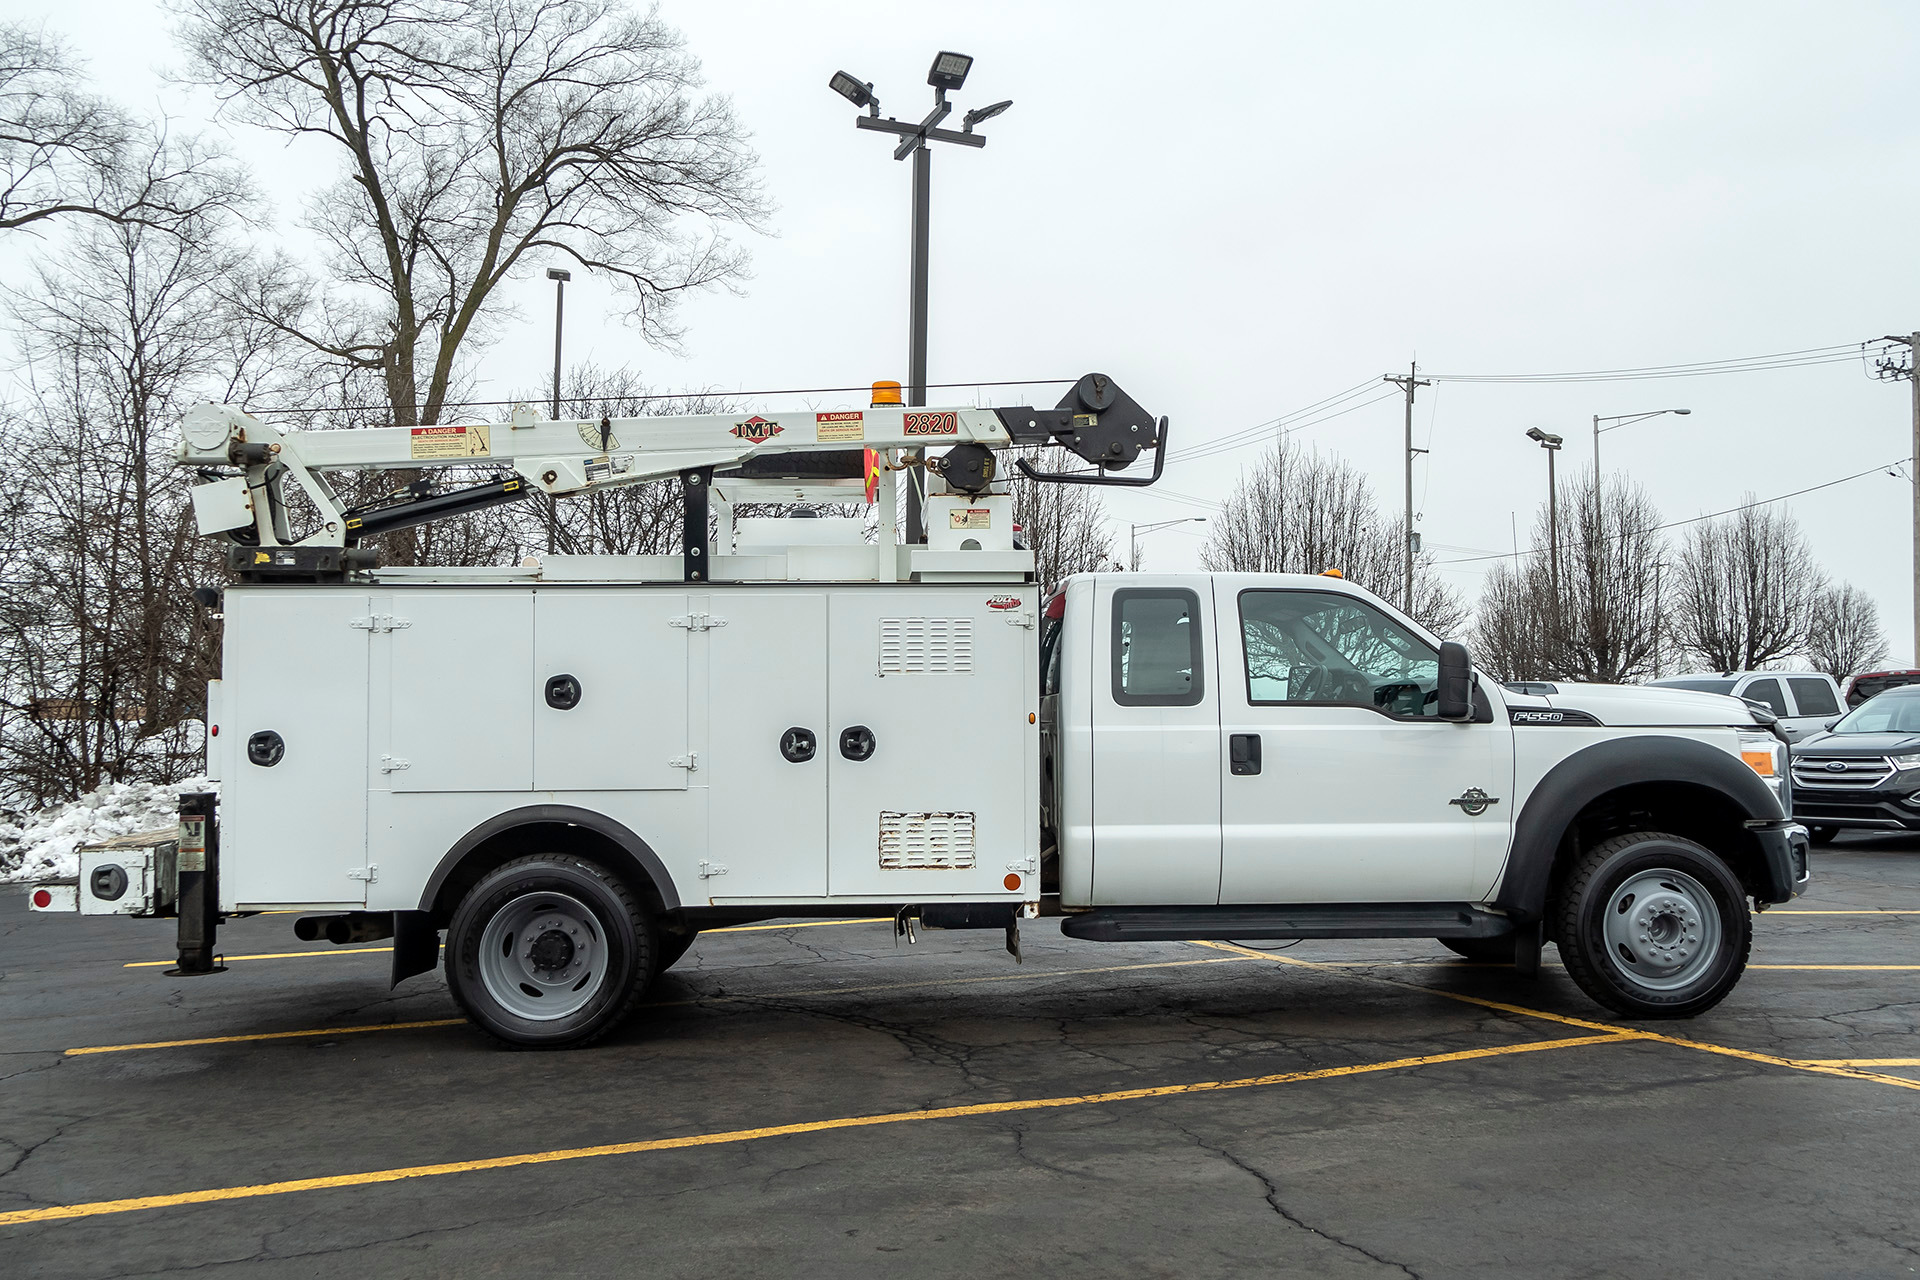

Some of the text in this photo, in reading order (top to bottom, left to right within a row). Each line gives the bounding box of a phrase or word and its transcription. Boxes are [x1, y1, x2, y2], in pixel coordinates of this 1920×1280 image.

[735, 422, 778, 438] IMT
[906, 413, 955, 434] 2820
[428, 427, 457, 435] DANGER
[1513, 711, 1563, 722] F-550
